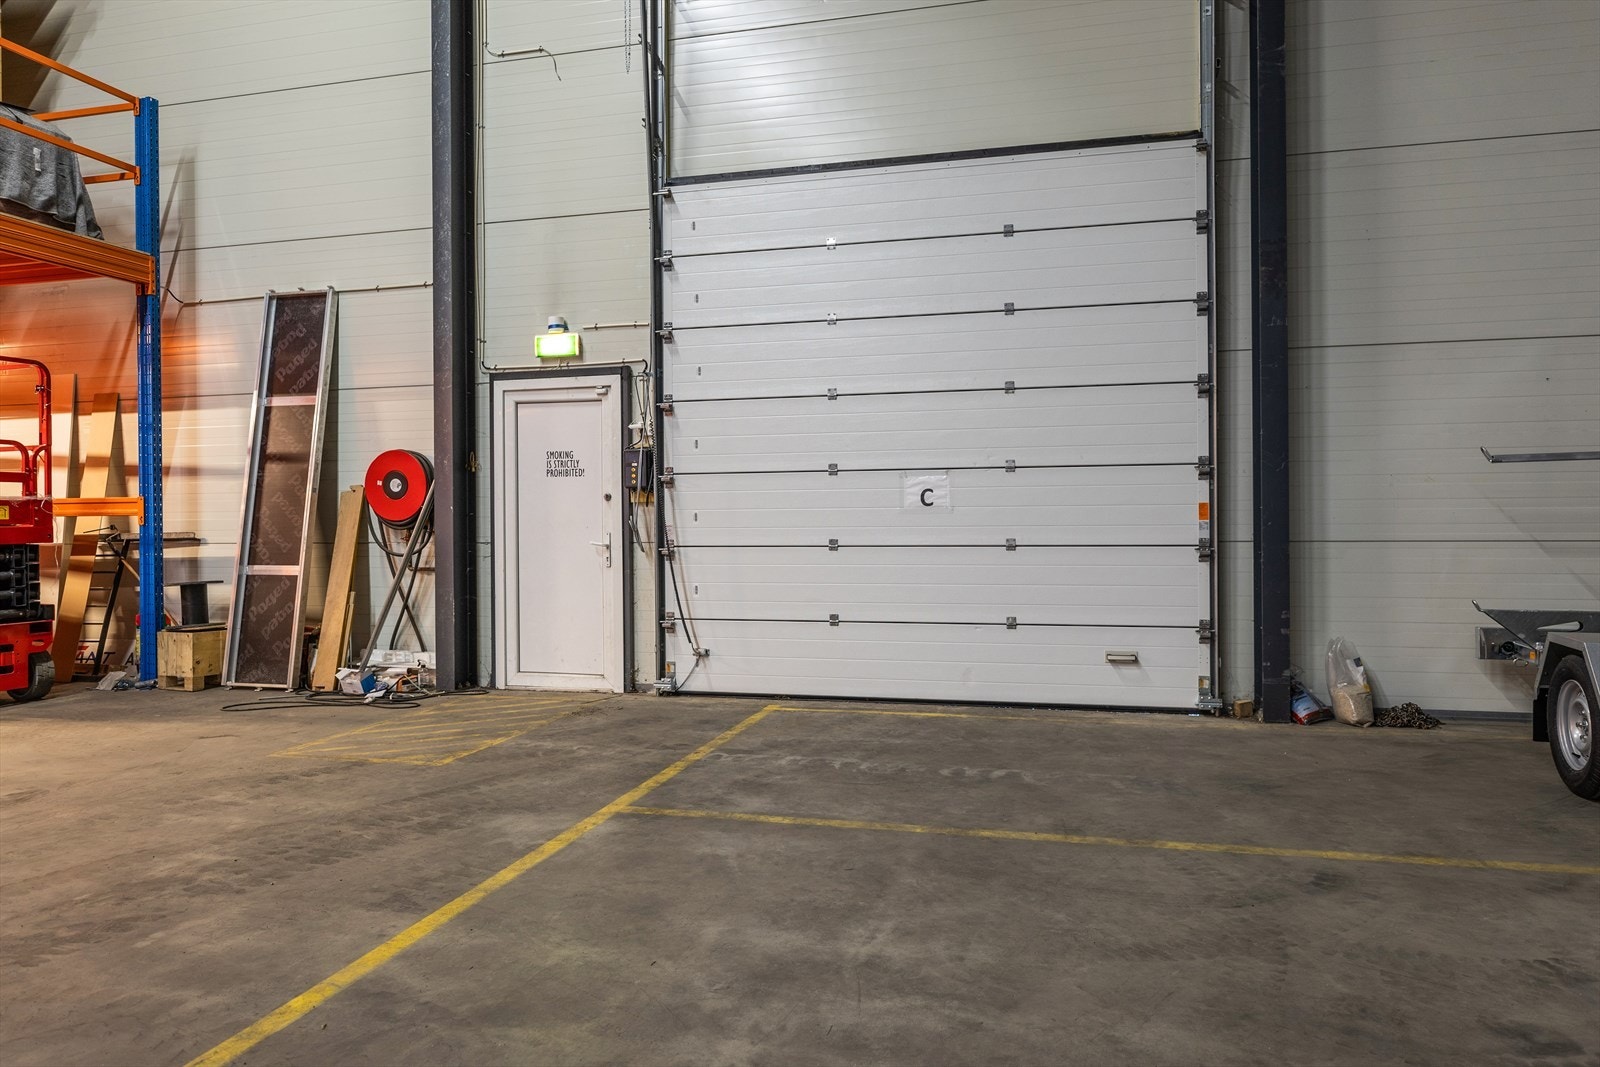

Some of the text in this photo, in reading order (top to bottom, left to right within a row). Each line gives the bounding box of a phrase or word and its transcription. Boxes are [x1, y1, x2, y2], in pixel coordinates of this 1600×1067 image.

[546, 450, 574, 460] SMOKING
[546, 460, 580, 468] IS STRICTLY
[546, 468, 585, 477] PROHIBITED!
[920, 488, 934, 507] C
